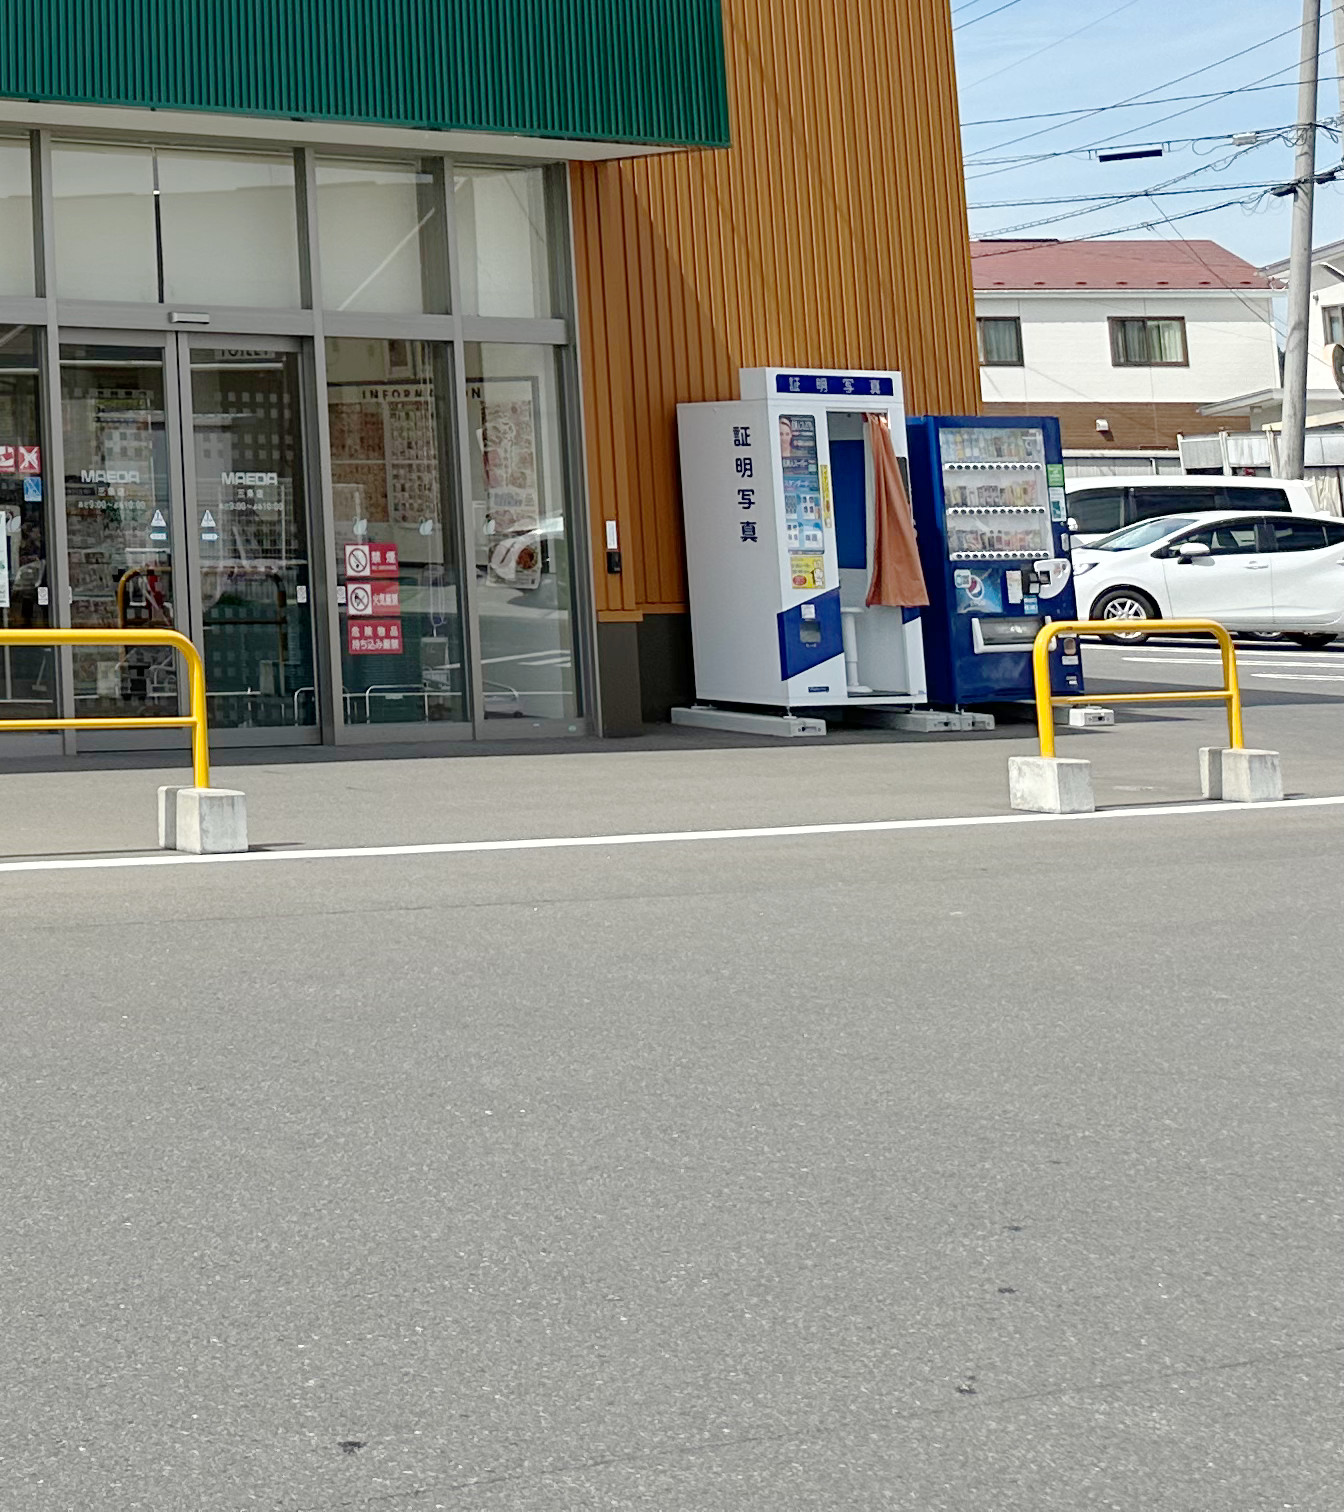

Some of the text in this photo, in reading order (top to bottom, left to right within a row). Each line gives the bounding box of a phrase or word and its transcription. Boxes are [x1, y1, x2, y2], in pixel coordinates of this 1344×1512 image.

[789, 376, 881, 395] 証明写真
[81, 469, 140, 484] MAEDA
[221, 471, 278, 486] MAEDA
[732, 426, 758, 543] 証明写真
